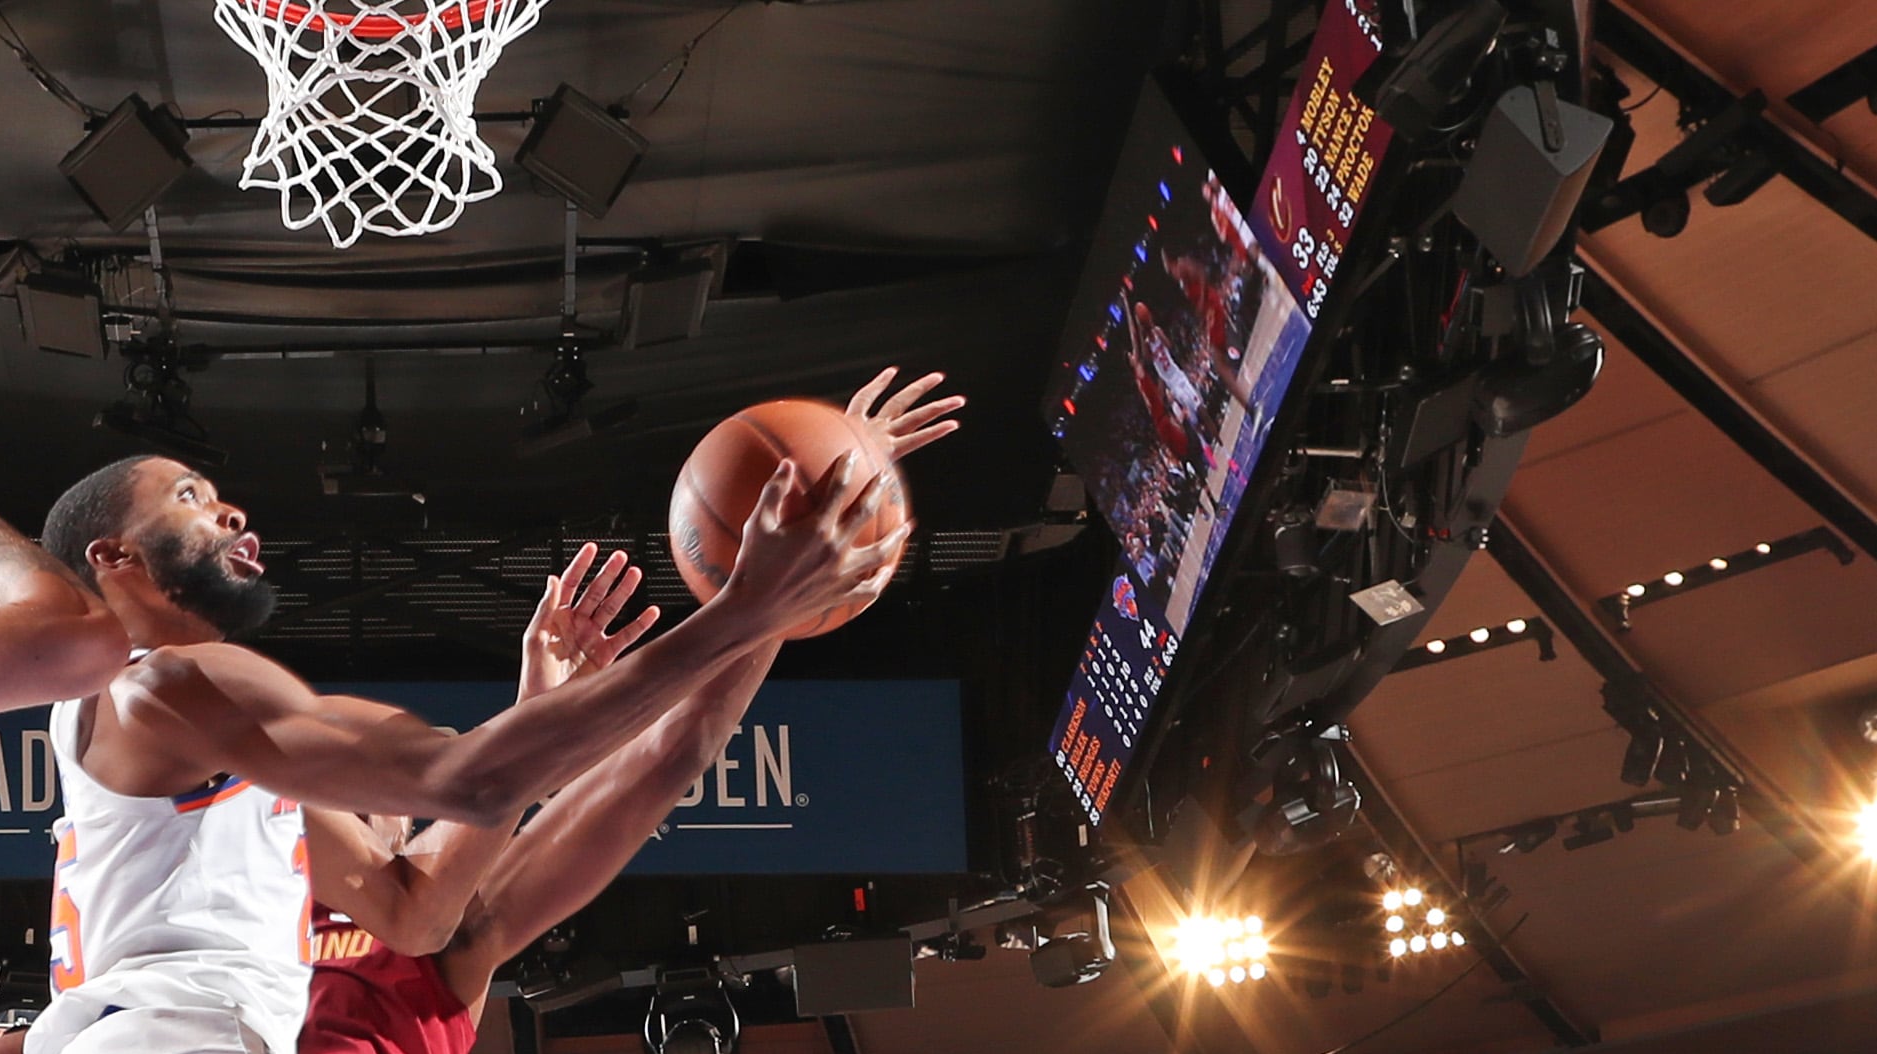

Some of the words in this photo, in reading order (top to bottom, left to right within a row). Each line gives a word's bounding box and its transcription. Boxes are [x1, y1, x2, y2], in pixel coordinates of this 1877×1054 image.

[1300, 56, 1333, 134] MOBLEY
[1304, 147, 1318, 175] 20
[1312, 88, 1340, 150] TYSON
[1315, 165, 1330, 193] 22
[1324, 108, 1352, 170] NANCE
[1326, 184, 1342, 211] 24
[1338, 201, 1354, 228] 32
[1347, 151, 1374, 204] WADE
[1292, 227, 1315, 269] 33
[1316, 242, 1330, 268] FLS
[1324, 253, 1339, 279] TOL
[1307, 278, 1328, 319] 6:43
[1140, 618, 1156, 649] 44
[1162, 634, 1178, 667] 6:43
[1061, 697, 1087, 753] CLARKSON
[1069, 730, 1089, 769] KOLEK
[1077, 735, 1101, 784] BRIDGES
[1086, 759, 1106, 798] TOWNS
[1095, 757, 1122, 813] HUKPORTI
